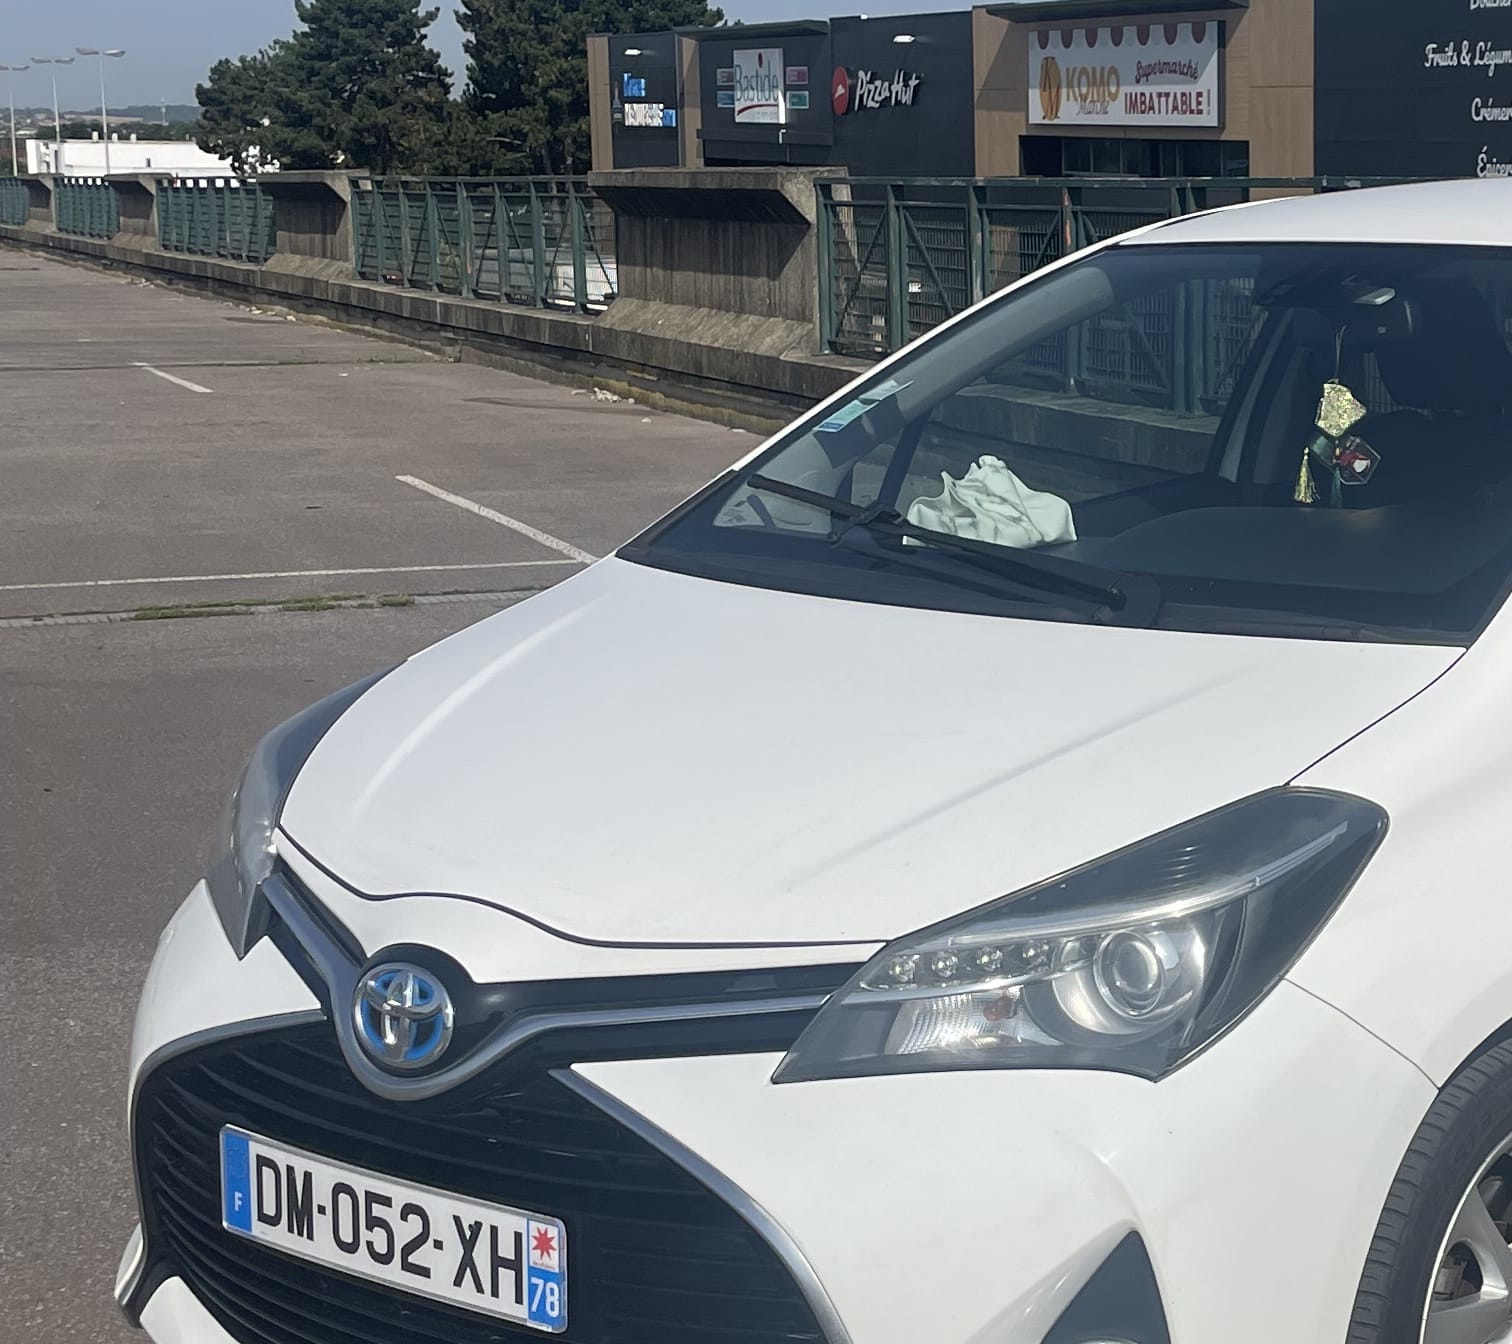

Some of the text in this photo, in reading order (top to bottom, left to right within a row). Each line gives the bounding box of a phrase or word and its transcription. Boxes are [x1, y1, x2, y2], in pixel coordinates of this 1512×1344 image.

[1135, 58, 1199, 84] Supermarché
[1424, 41, 1458, 67] Fruits
[1460, 40, 1471, 66] &
[854, 67, 920, 111] Pizza Hut
[1066, 65, 1121, 102] KOMO
[234, 1191, 243, 1212] F
[255, 1154, 525, 1306] DM-052-XH
[530, 1276, 560, 1318] 78
